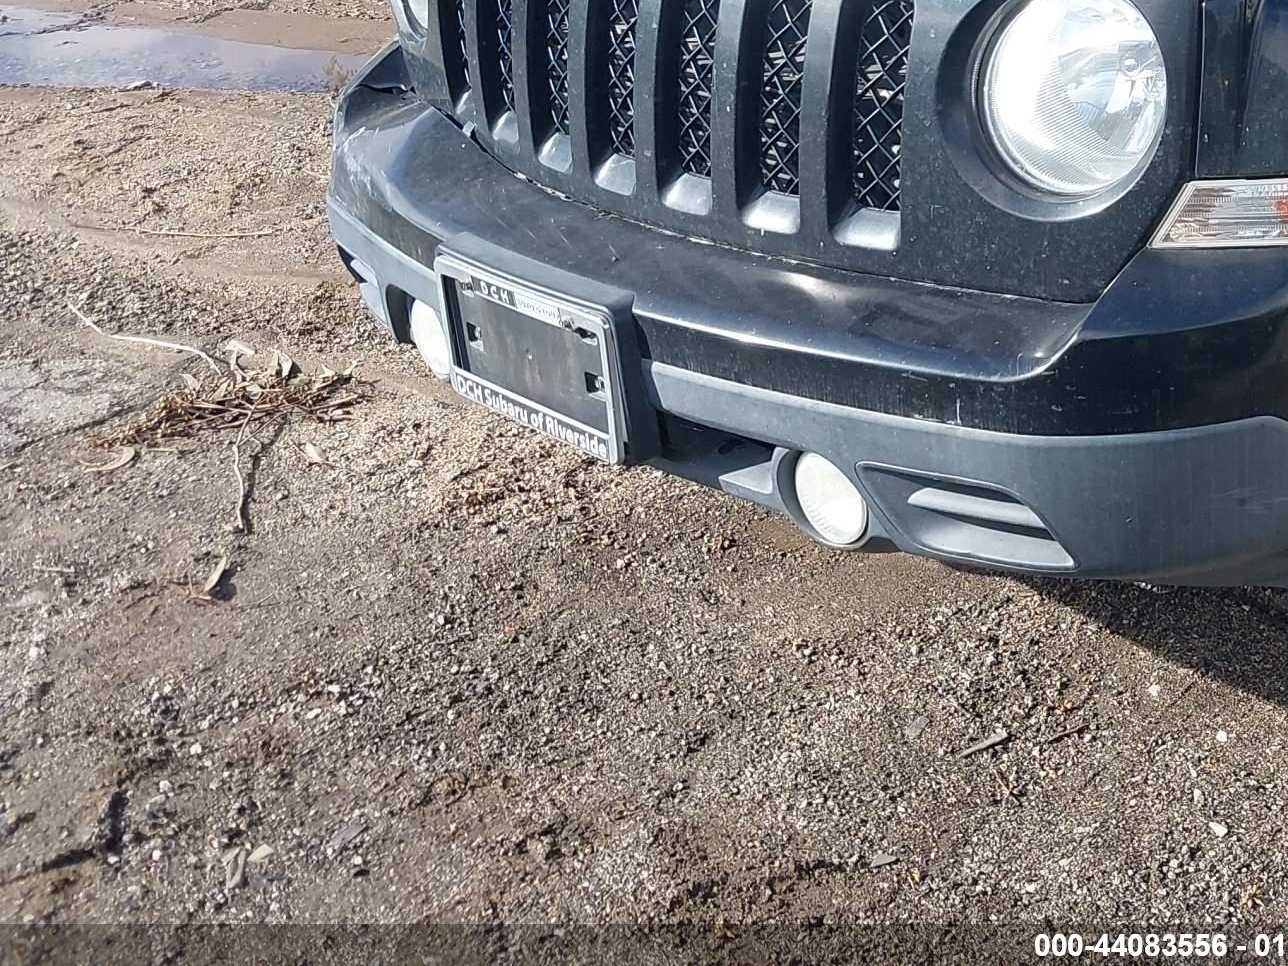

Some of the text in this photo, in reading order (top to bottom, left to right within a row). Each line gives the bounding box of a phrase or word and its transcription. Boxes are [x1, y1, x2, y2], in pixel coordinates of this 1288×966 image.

[480, 280, 510, 304] DCH
[457, 375, 608, 459] DCH Subaru of Riverside
